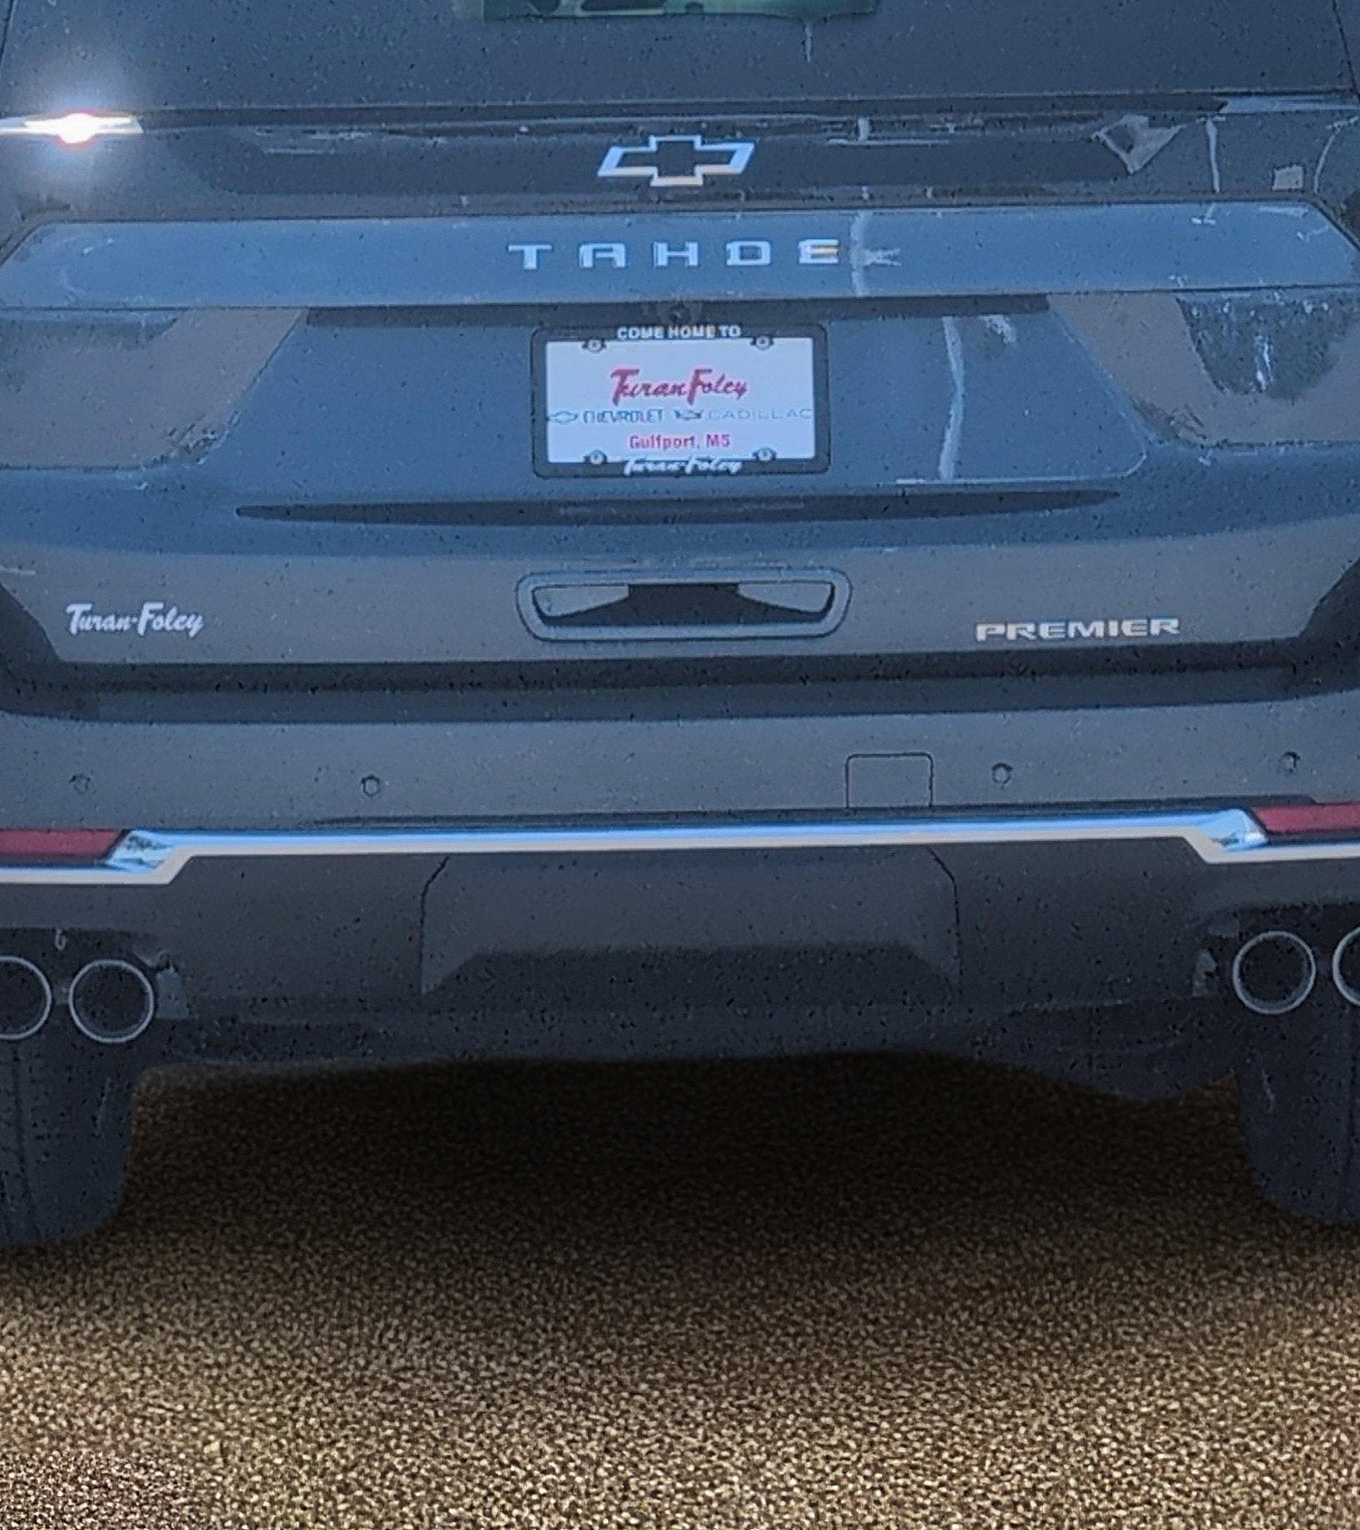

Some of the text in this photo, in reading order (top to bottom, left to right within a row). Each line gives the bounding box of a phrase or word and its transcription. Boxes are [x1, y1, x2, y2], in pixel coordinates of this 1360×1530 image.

[507, 238, 840, 270] TAHOE
[616, 323, 742, 340] COME HOME TO
[582, 407, 813, 424] CHEVROLET CADILLAC
[629, 433, 701, 451] Gulfport,
[975, 617, 1182, 643] PREMIER
